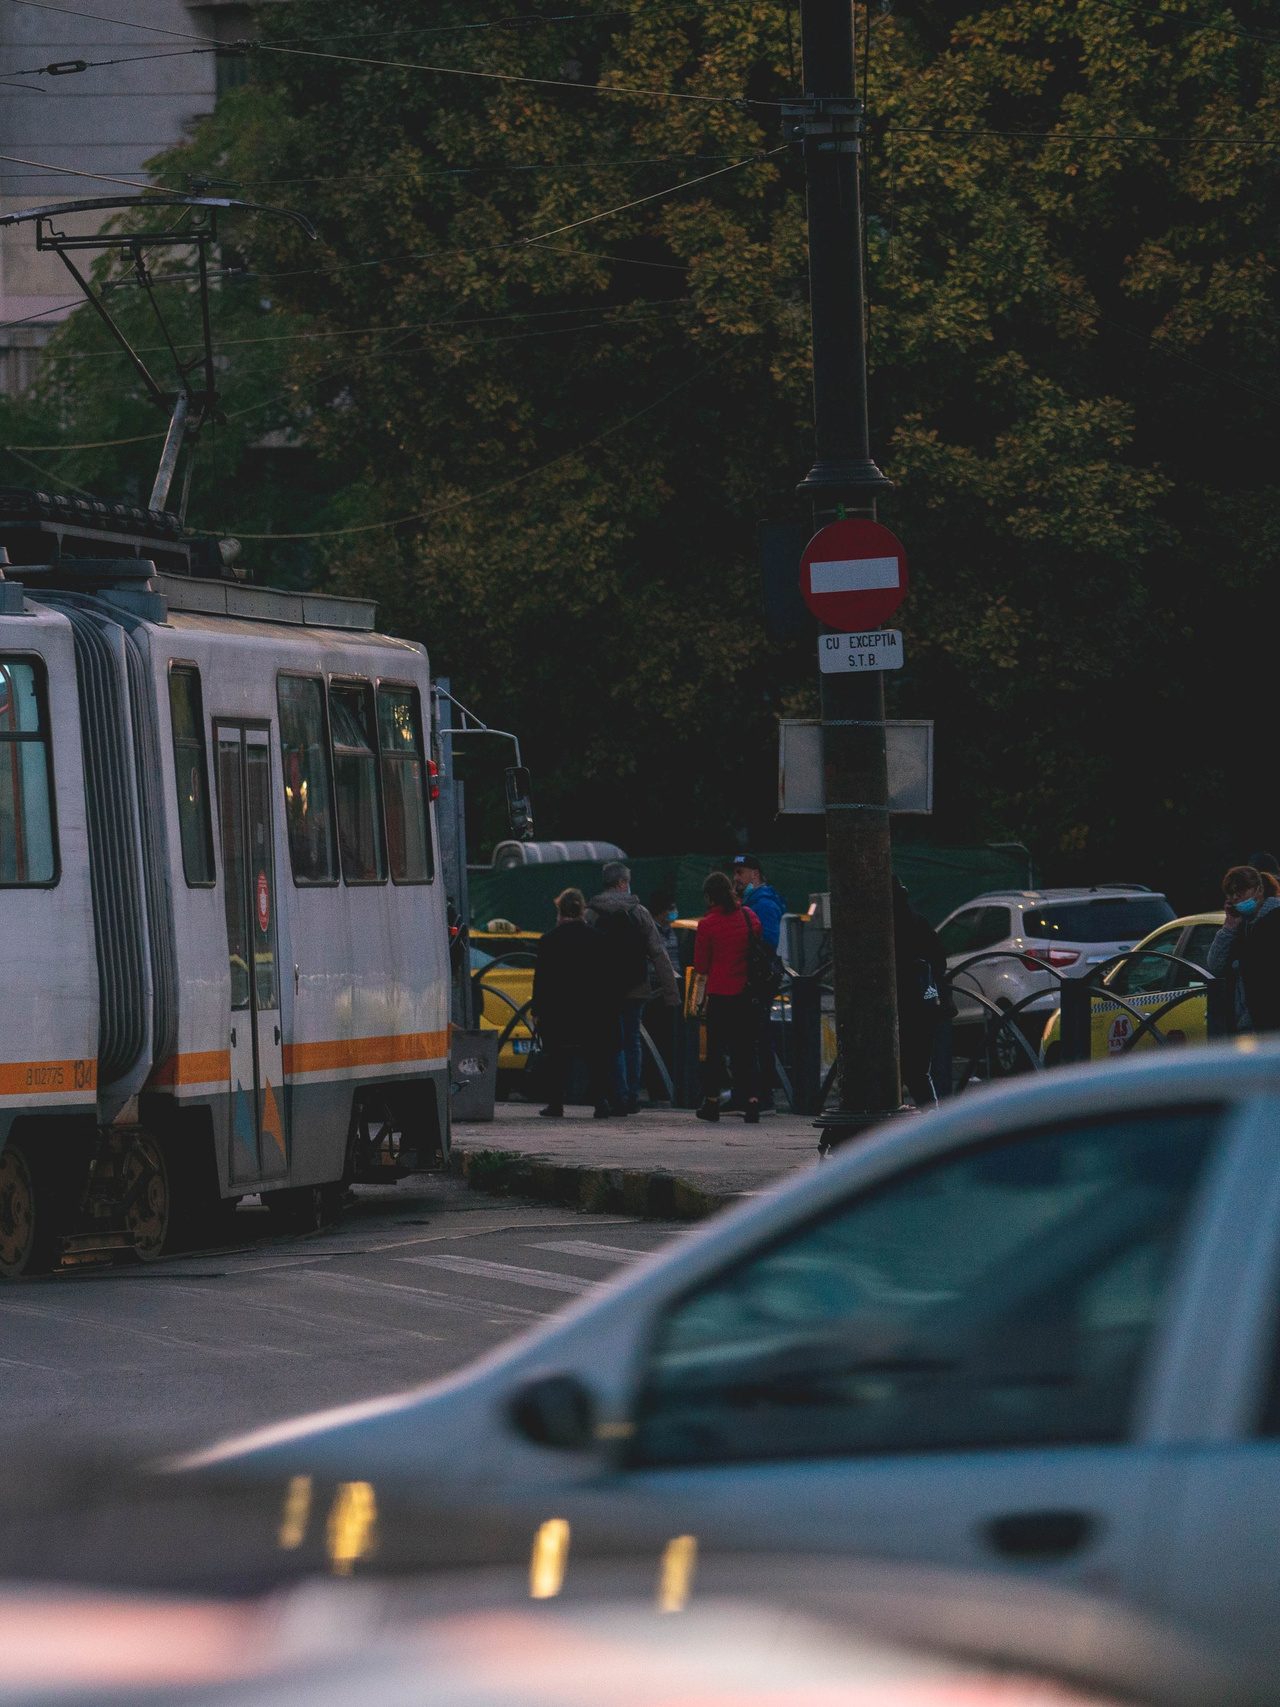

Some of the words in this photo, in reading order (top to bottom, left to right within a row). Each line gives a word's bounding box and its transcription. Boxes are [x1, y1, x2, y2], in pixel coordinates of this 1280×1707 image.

[825, 637, 840, 650] CU
[849, 633, 897, 649] EXCEPTIA
[848, 653, 878, 667] S.T.B.
[1113, 1019, 1128, 1038] AS
